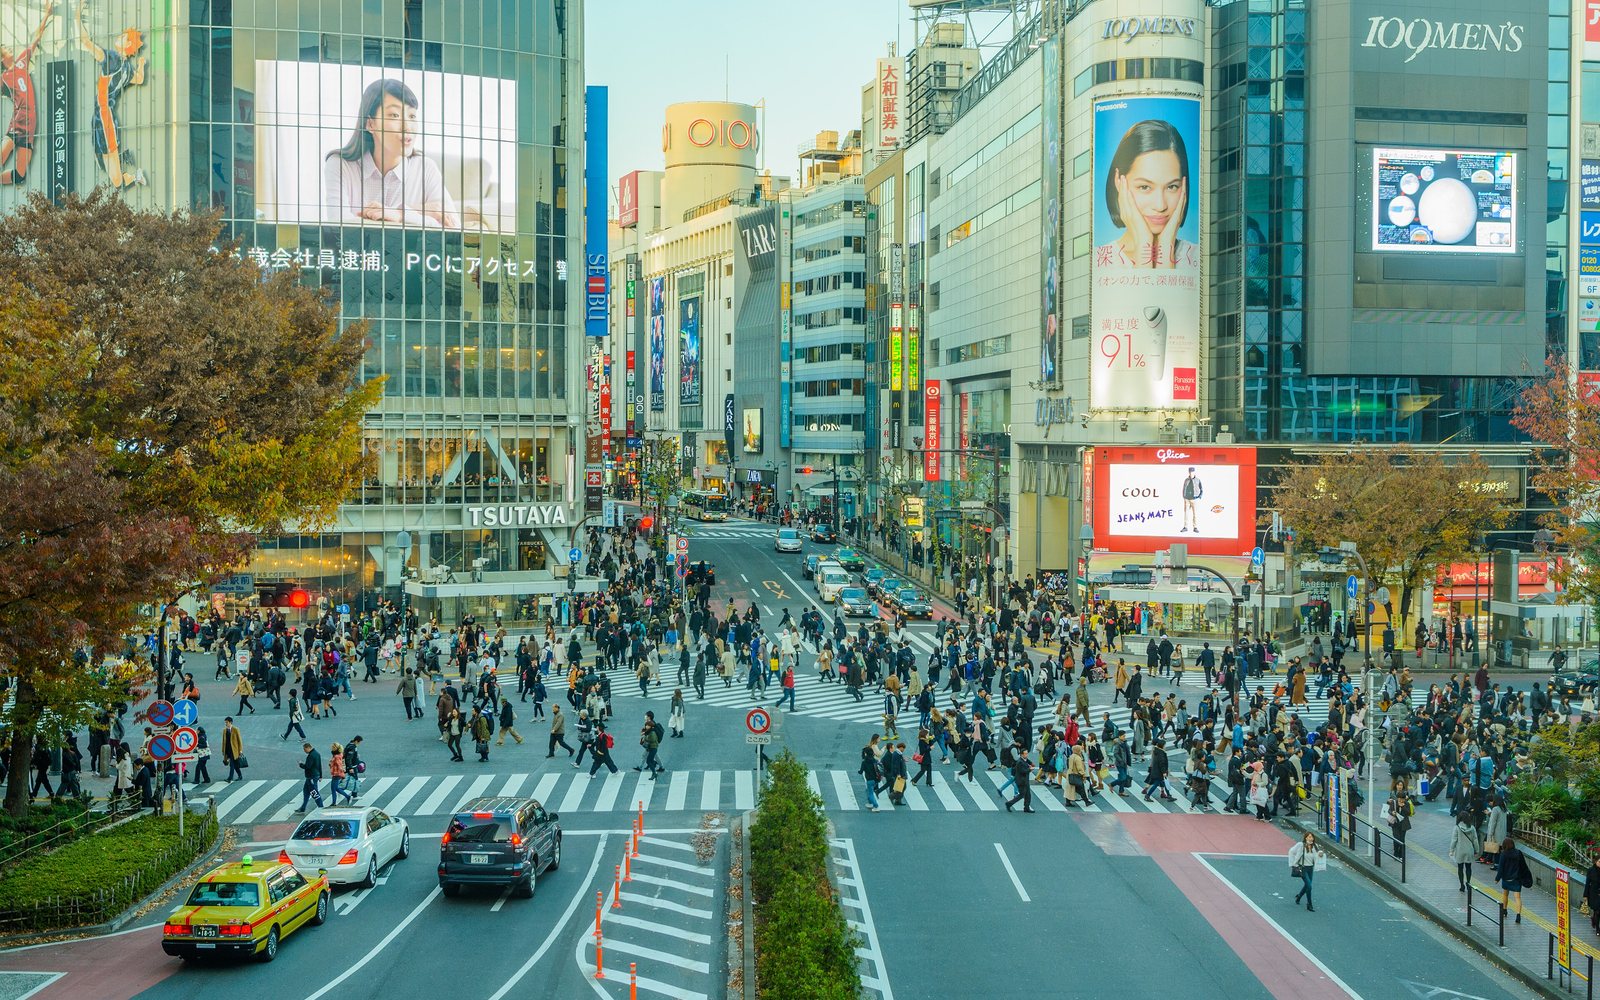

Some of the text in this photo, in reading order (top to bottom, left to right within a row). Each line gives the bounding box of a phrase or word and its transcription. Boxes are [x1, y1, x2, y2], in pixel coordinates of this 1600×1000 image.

[882, 64, 898, 130] 大和証券
[1096, 101, 1128, 112] Panasonic
[1097, 242, 1198, 267] 深く、美しく。
[1582, 256, 1597, 264] 0120
[588, 253, 607, 321] SEIBU
[1587, 285, 1598, 293] 6F
[1102, 317, 1139, 330] 満足度
[1174, 375, 1195, 384] Panasonic
[1174, 384, 1190, 393] Beauty
[726, 399, 734, 431] ZARA
[1156, 449, 1191, 463] Glico
[1122, 487, 1159, 498] COOL
[468, 505, 566, 527] TSUTAYA
[1557, 884, 1566, 963] 駐停車禁止
